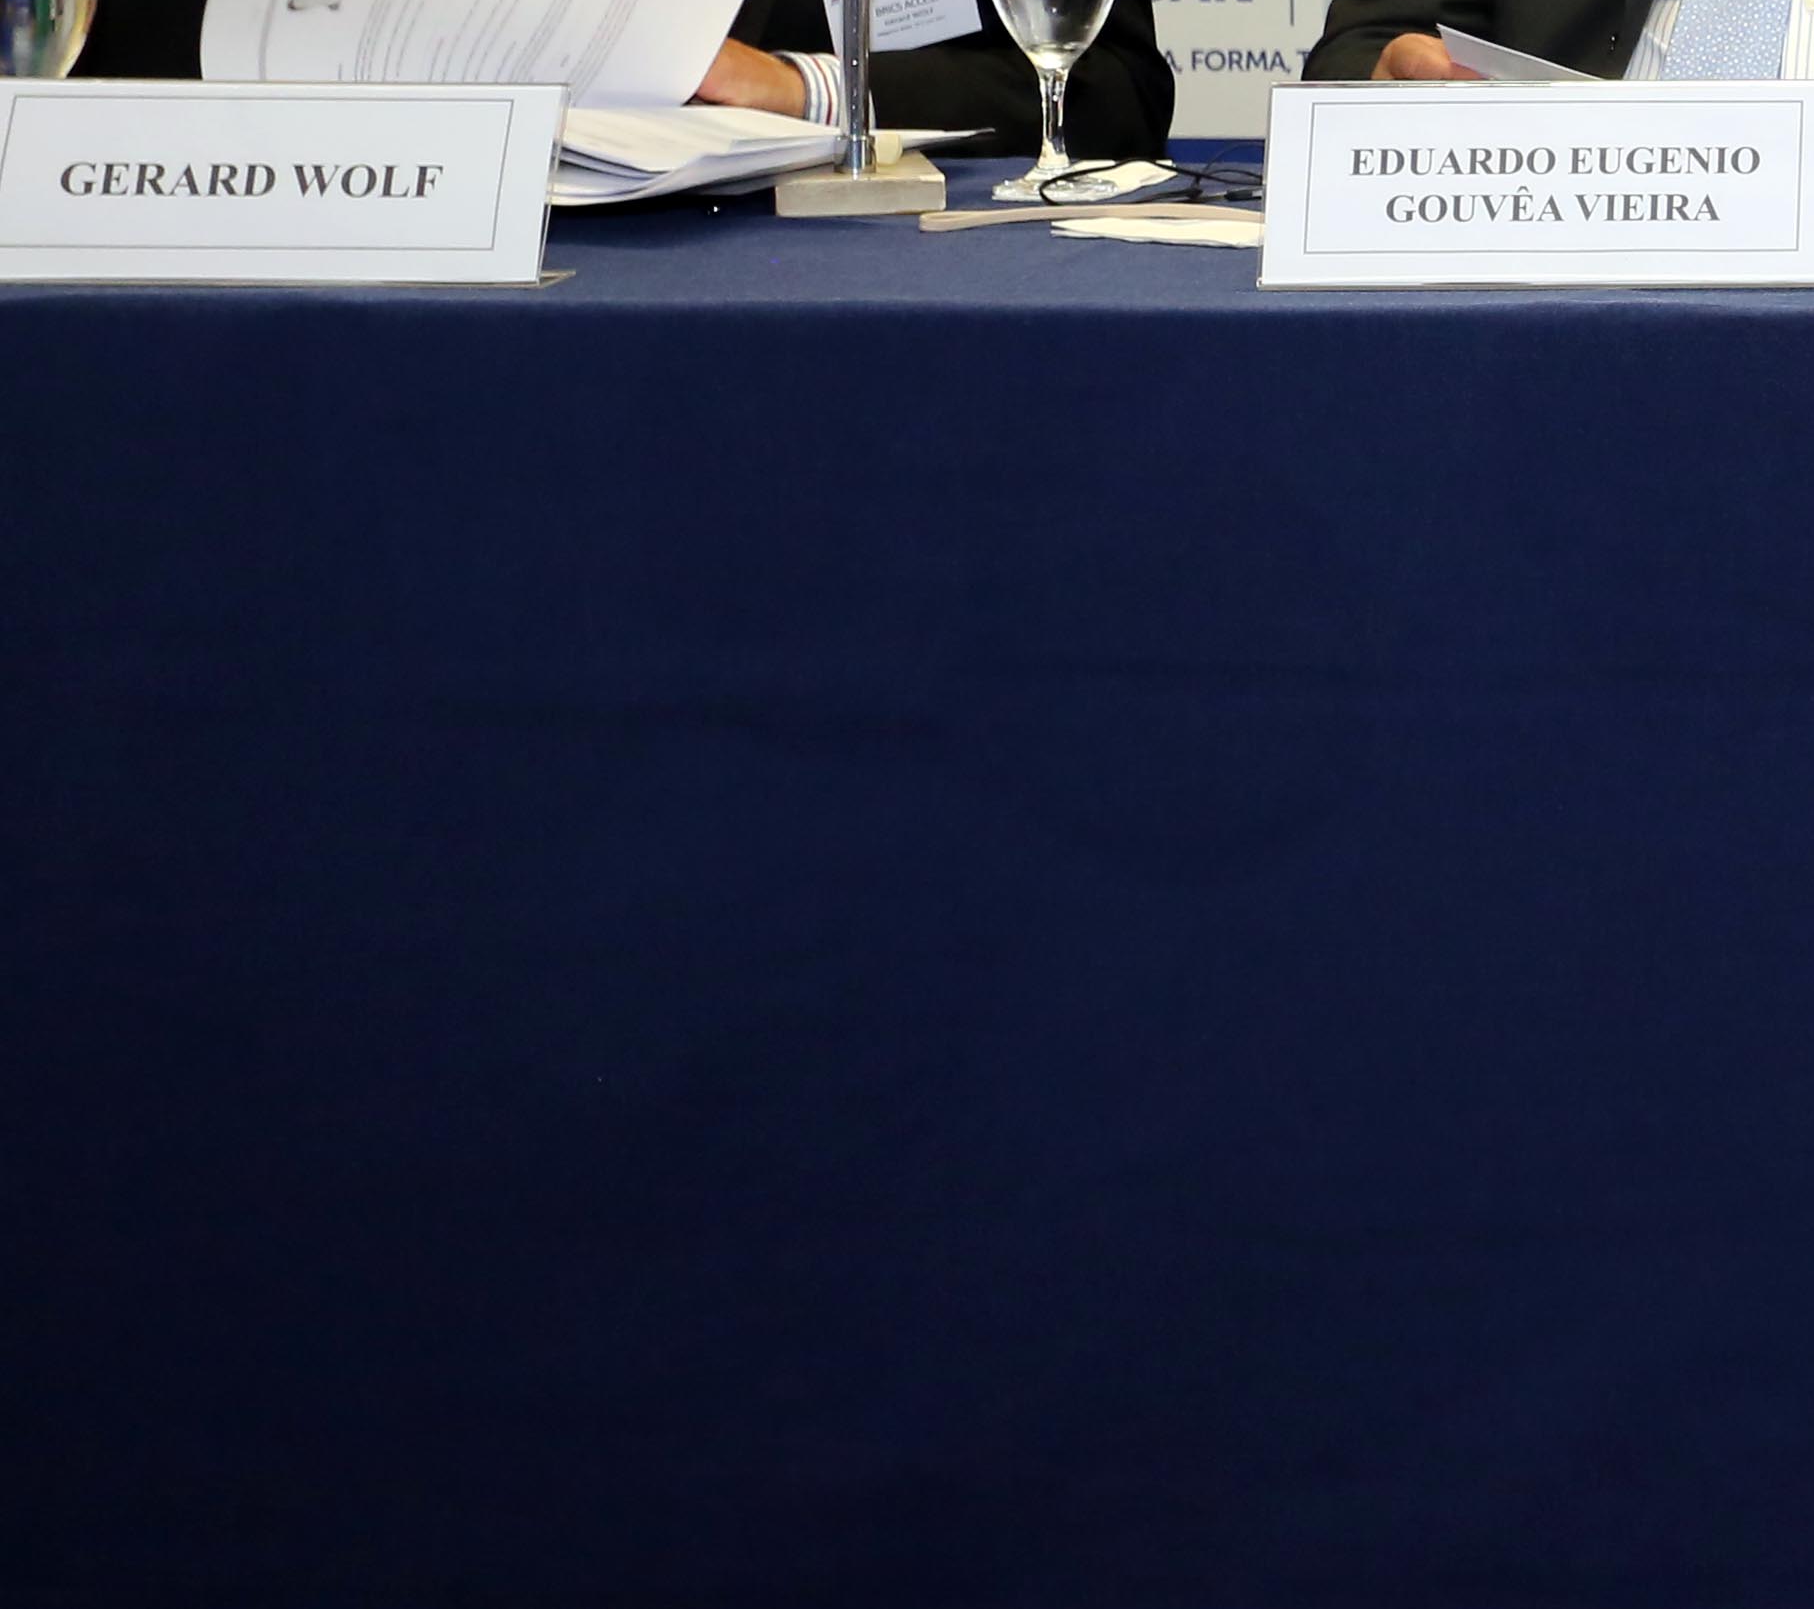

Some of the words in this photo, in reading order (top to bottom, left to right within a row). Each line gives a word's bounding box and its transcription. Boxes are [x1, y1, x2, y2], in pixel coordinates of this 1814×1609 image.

[1190, 50, 1291, 74] FORMA,
[1350, 146, 1557, 177] EDUARDO
[1569, 145, 1762, 176] EUGENIO
[60, 162, 277, 198] GERARD
[292, 163, 445, 199] WOLF
[1385, 184, 1563, 224] GOUVÊA
[1574, 192, 1721, 222] VIEIRA
